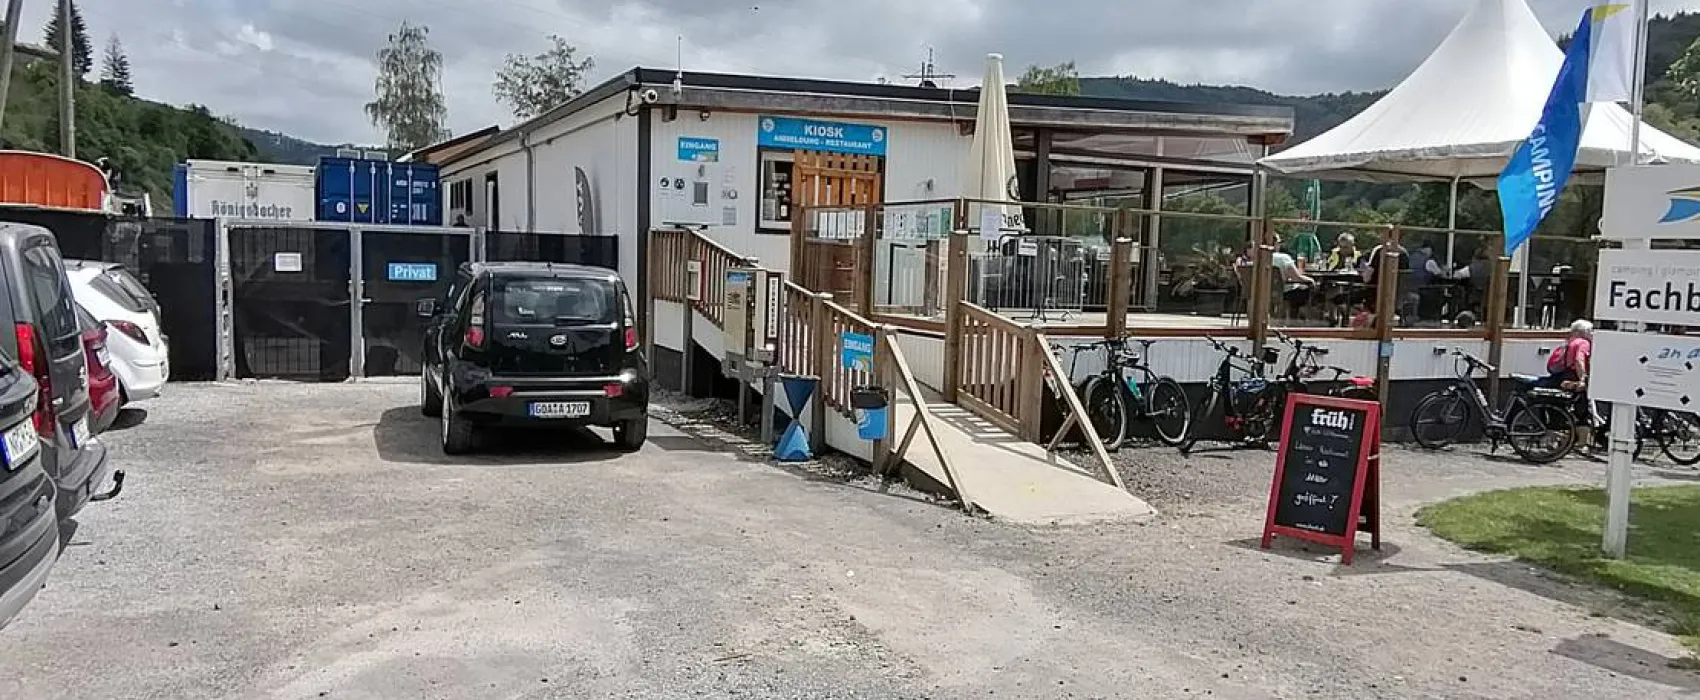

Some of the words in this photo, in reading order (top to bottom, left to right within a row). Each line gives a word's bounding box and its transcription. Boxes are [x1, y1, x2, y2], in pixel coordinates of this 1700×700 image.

[804, 125, 844, 138] KIOSK
[681, 141, 717, 151] EINGANG
[774, 134, 820, 146] ANMELDUNG
[825, 139, 873, 149] RESTAURANT
[211, 200, 292, 219] Königsbacher
[394, 265, 433, 278] Privat
[844, 339, 872, 353] EINGANG
[567, 404, 588, 414] 1707
